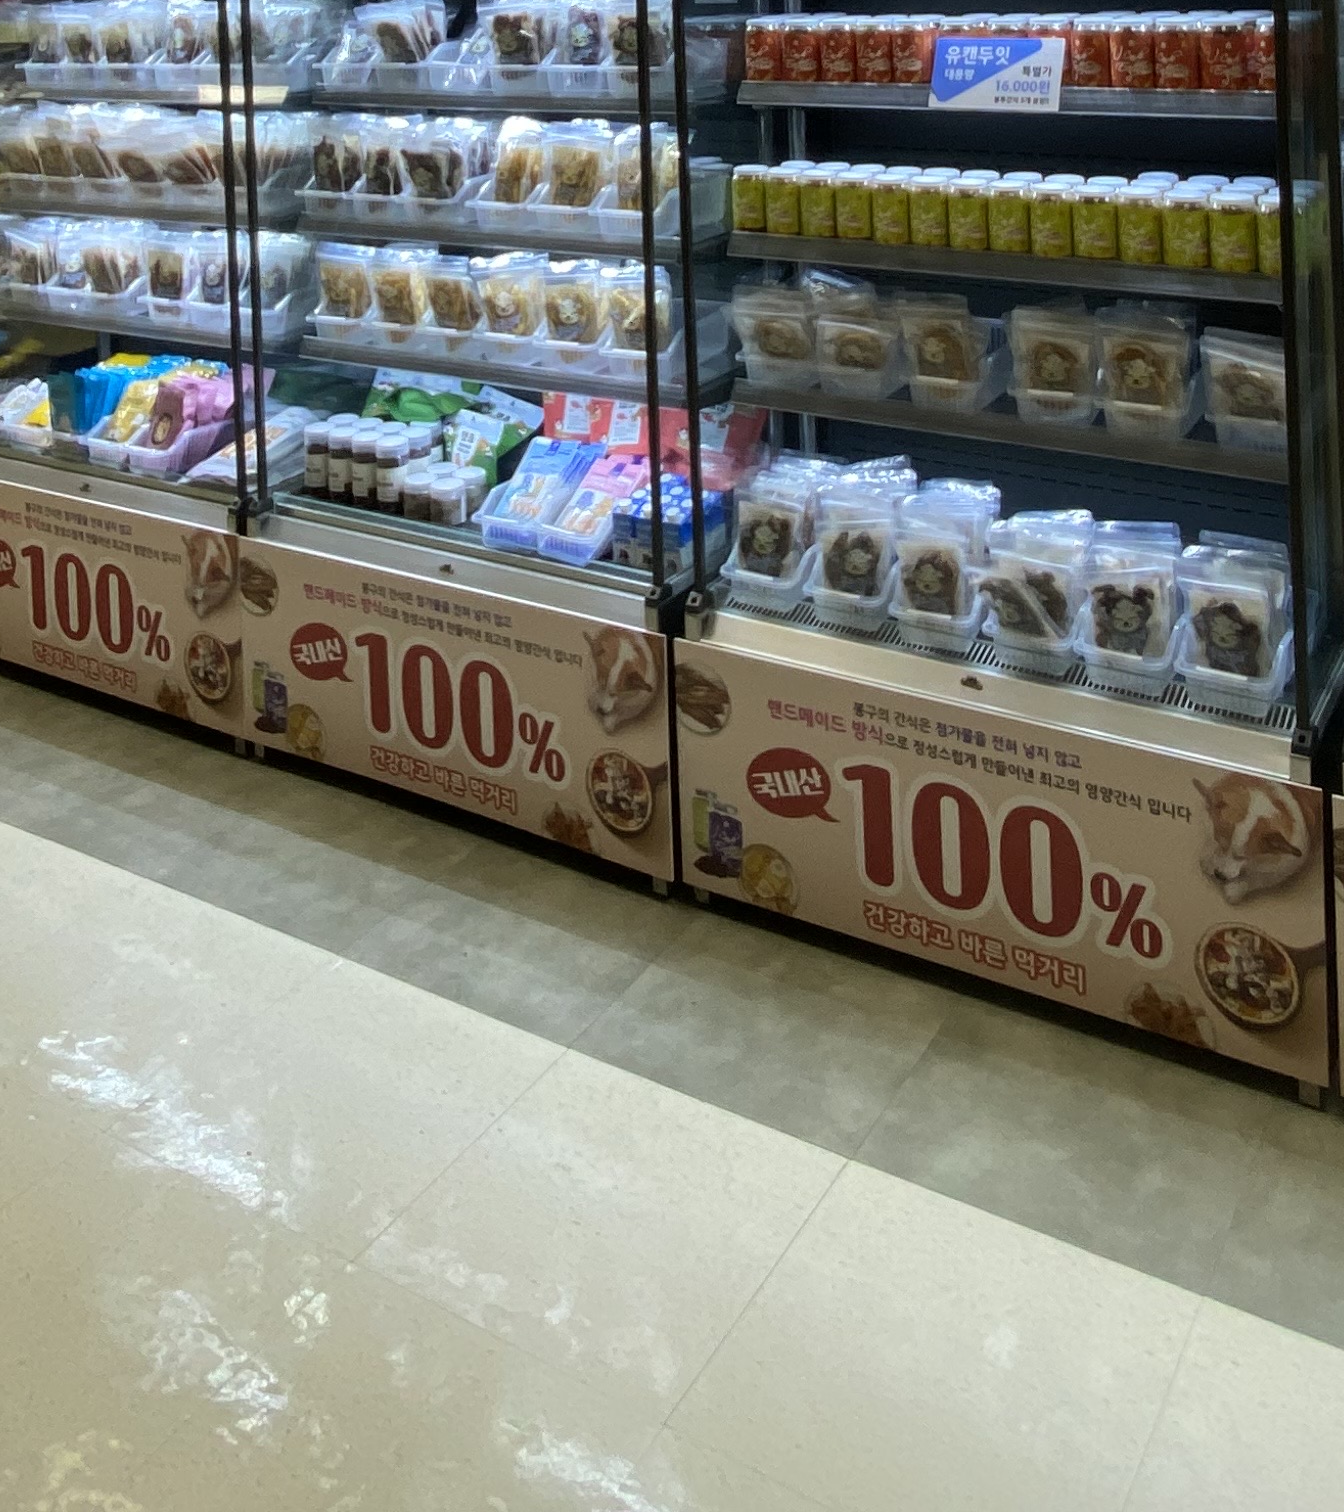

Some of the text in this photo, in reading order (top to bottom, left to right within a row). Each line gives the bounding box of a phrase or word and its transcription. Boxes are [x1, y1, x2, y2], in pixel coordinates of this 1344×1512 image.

[945, 45, 1011, 67] 유캔두잇
[21, 544, 171, 663] 100%
[292, 638, 344, 666] 국내산
[355, 631, 565, 783] 100%
[894, 710, 932, 734] 간식은
[370, 745, 517, 816] 건강하고 바른 먹거리
[751, 766, 824, 798] 국내산
[767, 698, 847, 734] 핸드메이드
[852, 720, 910, 751] 방식으로
[1039, 770, 1081, 796] 최고의
[1147, 797, 1193, 824] 입니다
[842, 763, 1165, 960] 100%
[864, 900, 1087, 996] 건강하고 바른 먹거리
